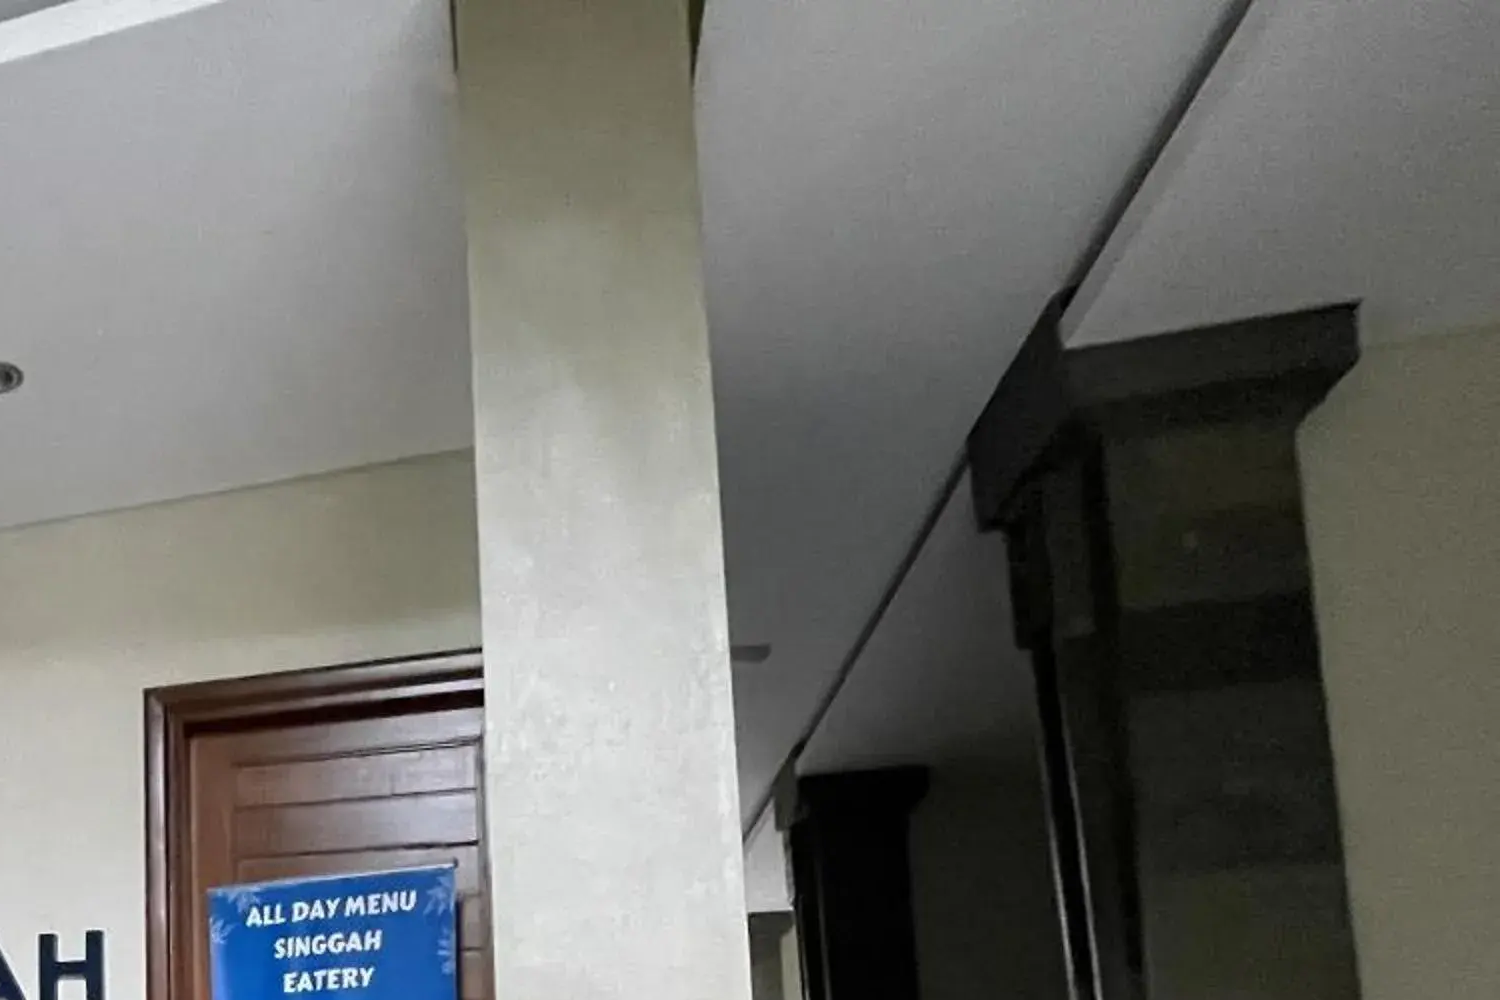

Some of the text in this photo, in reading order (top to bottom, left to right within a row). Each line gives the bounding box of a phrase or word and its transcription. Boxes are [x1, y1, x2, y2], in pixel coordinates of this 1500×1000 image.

[246, 889, 418, 928] ALL DAY MENU
[273, 930, 382, 959] SINGGAH
[282, 967, 375, 993] EATERY
